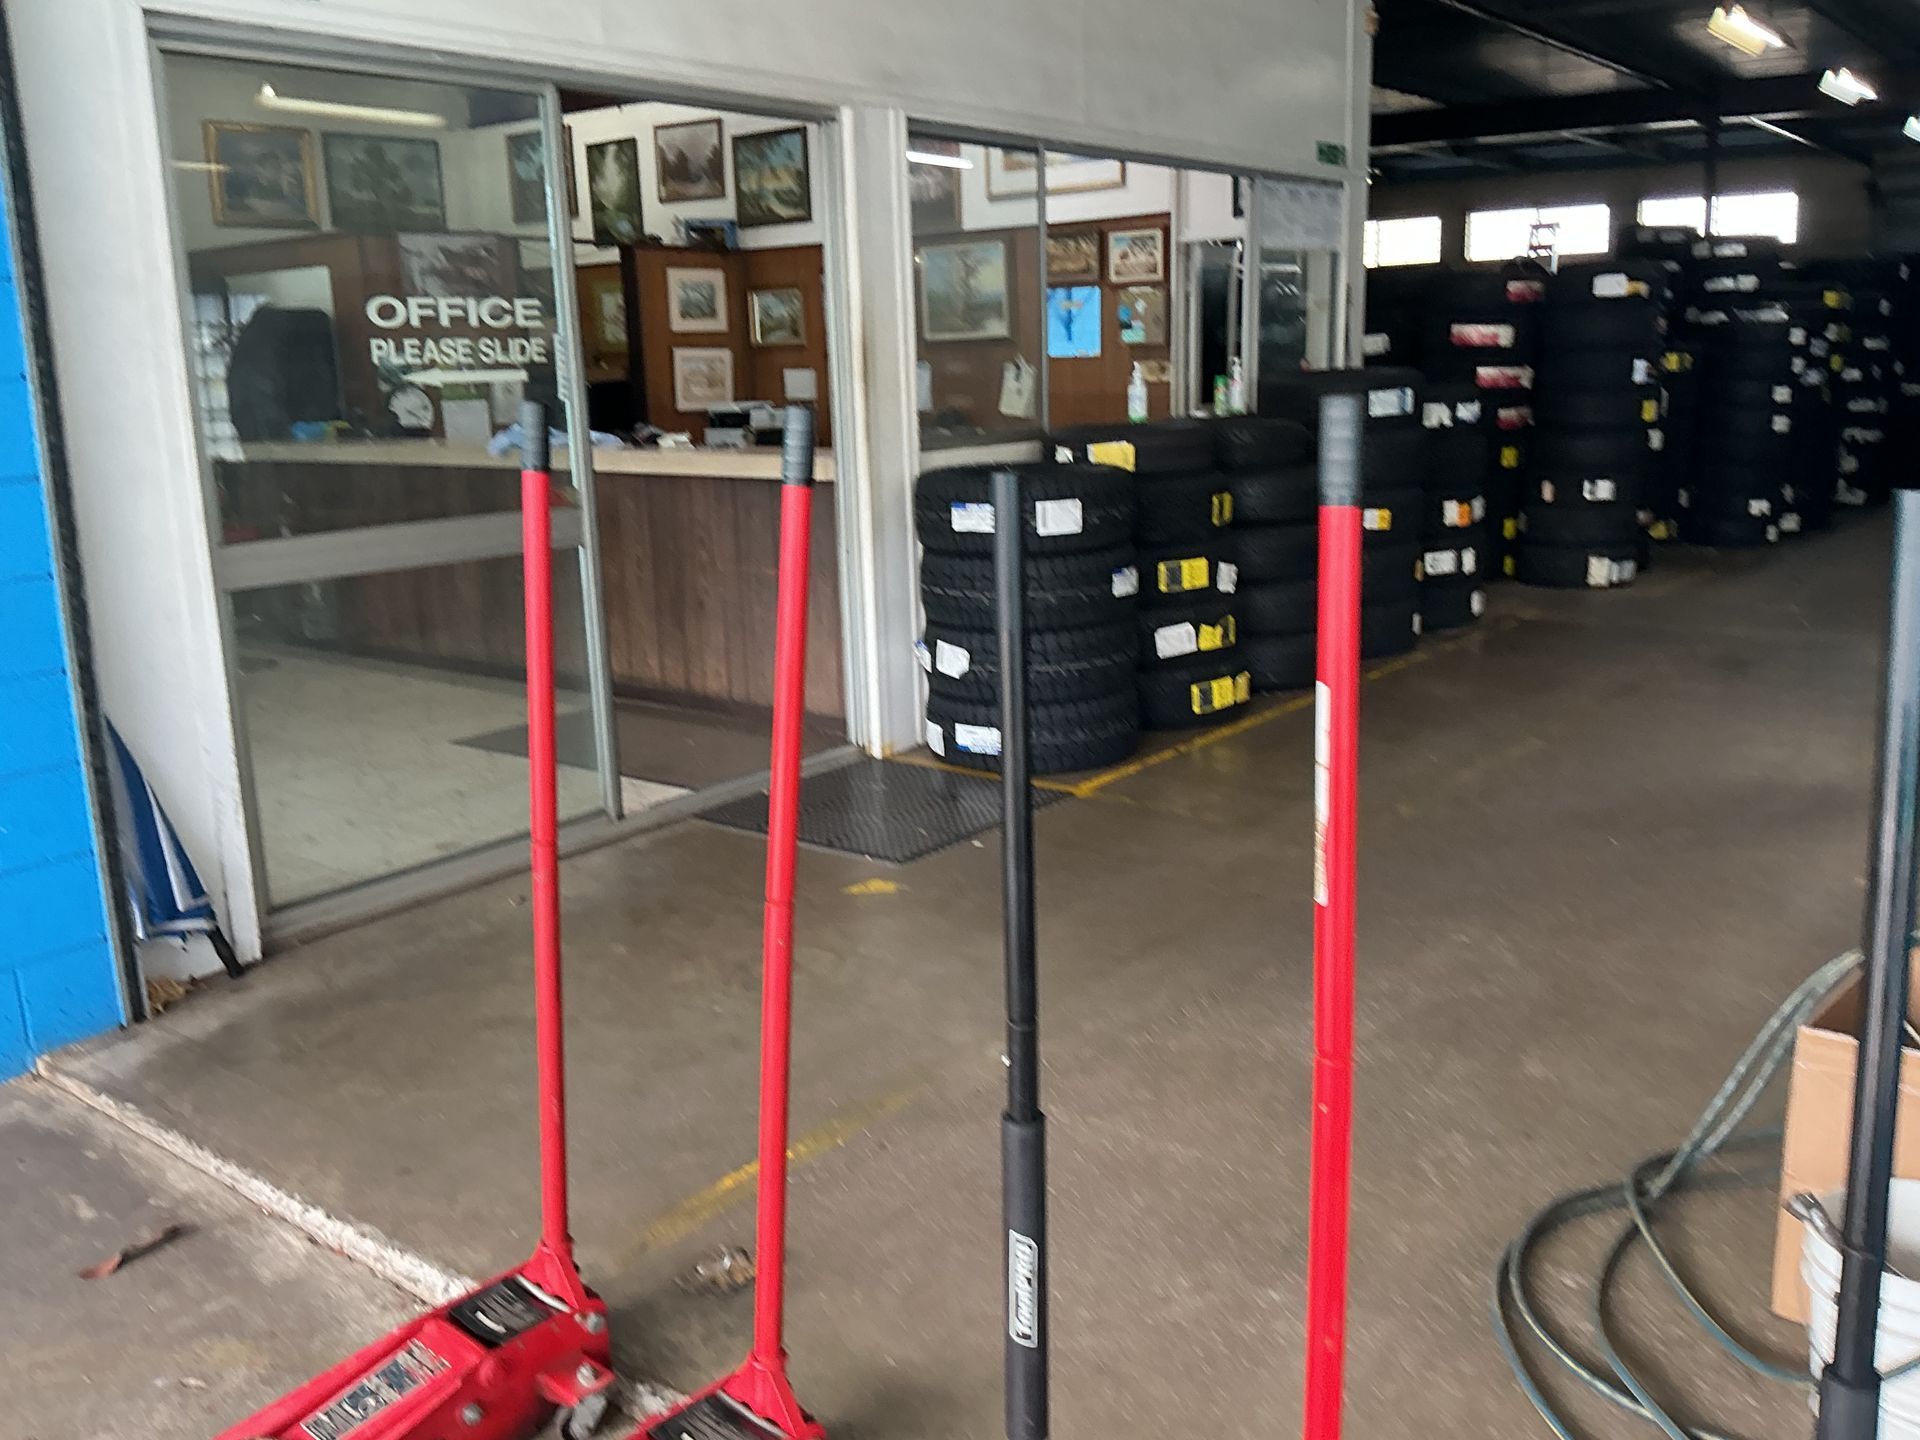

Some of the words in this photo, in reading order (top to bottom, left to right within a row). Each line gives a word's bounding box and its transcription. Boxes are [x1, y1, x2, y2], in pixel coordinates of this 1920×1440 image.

[366, 295, 545, 329] OFFICE
[369, 336, 475, 367] PLEASE
[478, 336, 549, 365] SLIDE
